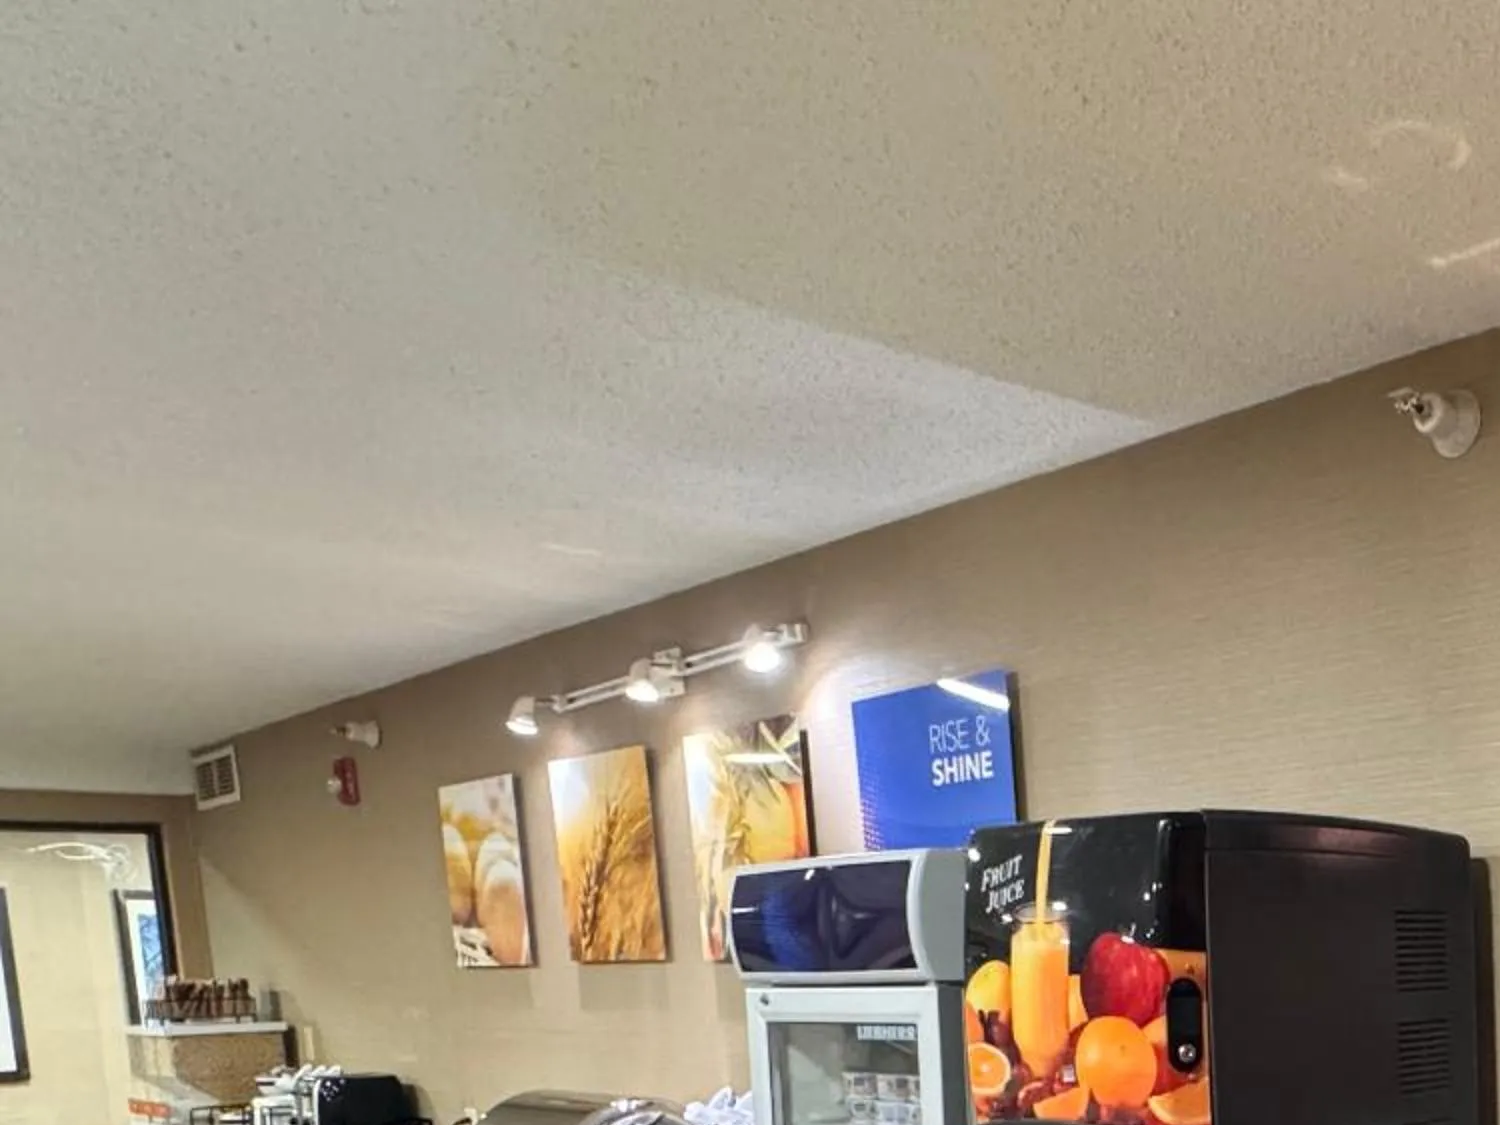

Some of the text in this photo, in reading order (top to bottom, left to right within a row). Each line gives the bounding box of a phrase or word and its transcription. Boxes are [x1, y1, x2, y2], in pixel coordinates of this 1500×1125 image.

[929, 715, 991, 753] RISE &
[931, 750, 994, 787] SHINE
[981, 854, 1023, 892] FRUIT
[985, 879, 1025, 913] JUICE
